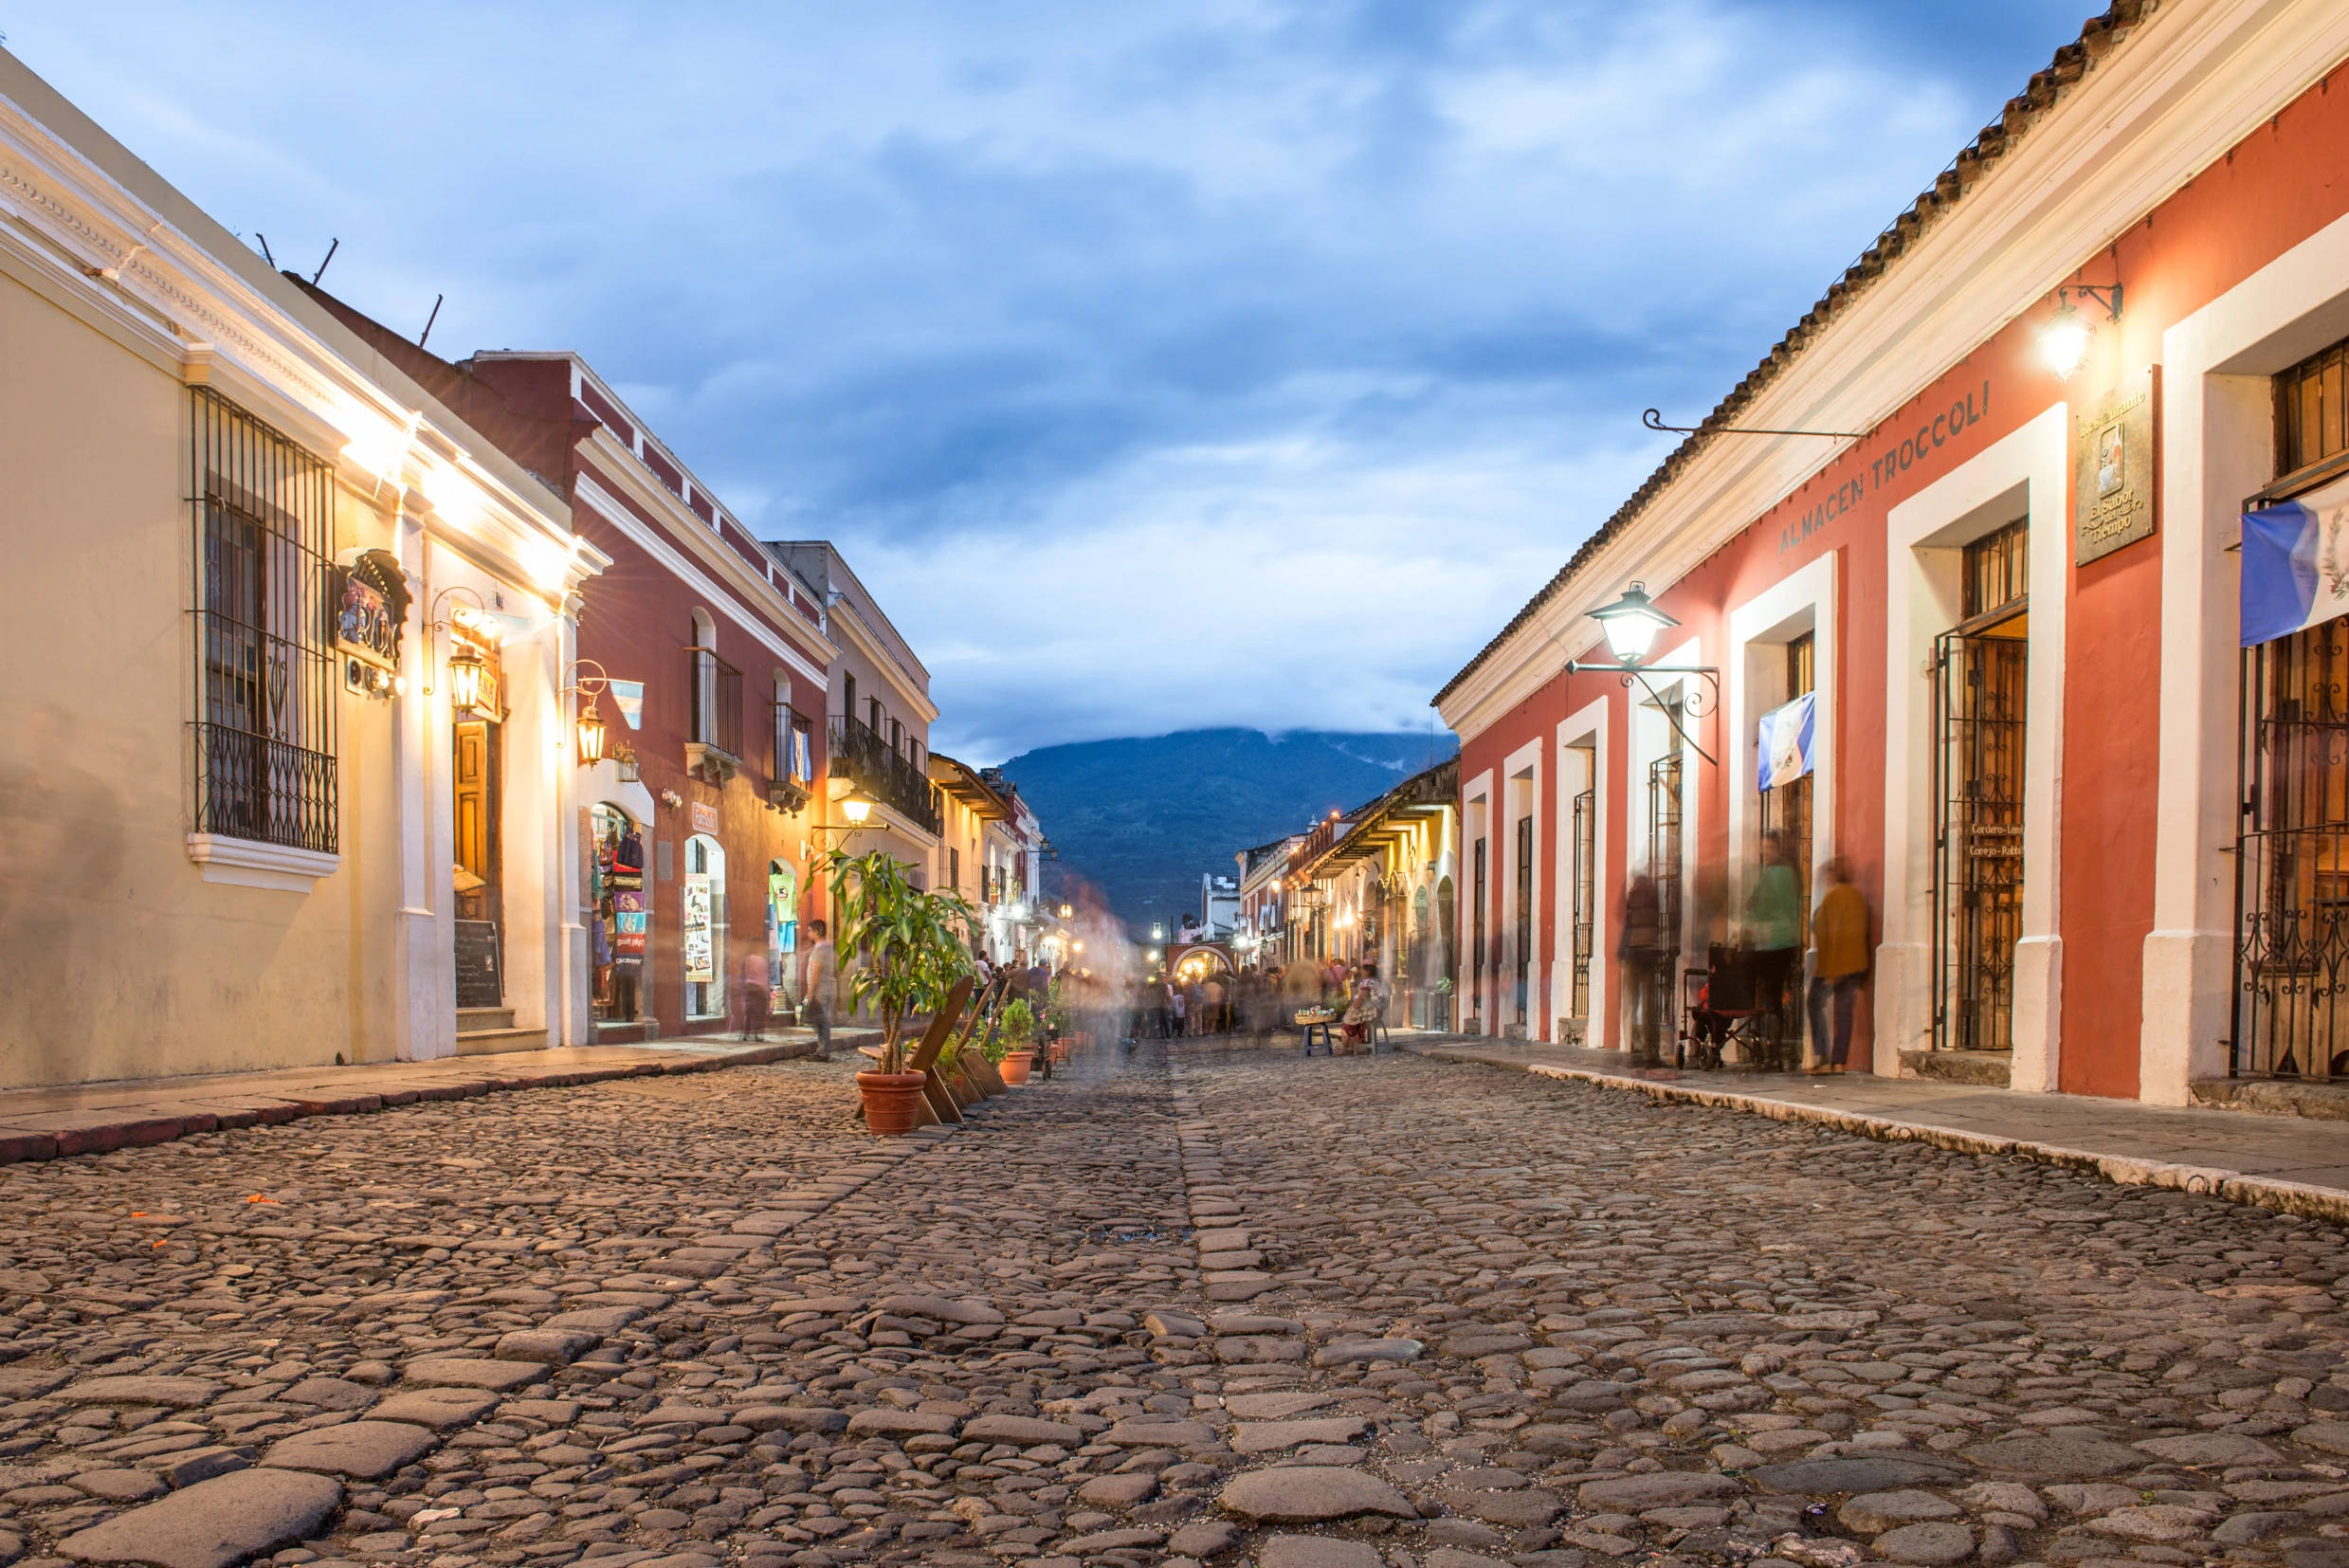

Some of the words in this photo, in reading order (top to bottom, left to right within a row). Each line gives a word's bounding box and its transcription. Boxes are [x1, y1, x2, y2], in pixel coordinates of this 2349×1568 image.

[2080, 390, 2146, 438] Restaurante
[1779, 473, 1864, 556] ALMACEN
[1872, 380, 1989, 489] TROCCOLI
[2090, 503, 2101, 520] El
[2103, 487, 2134, 516] Sabor
[2104, 512, 2117, 524] del
[2091, 515, 2132, 544] Tiempo
